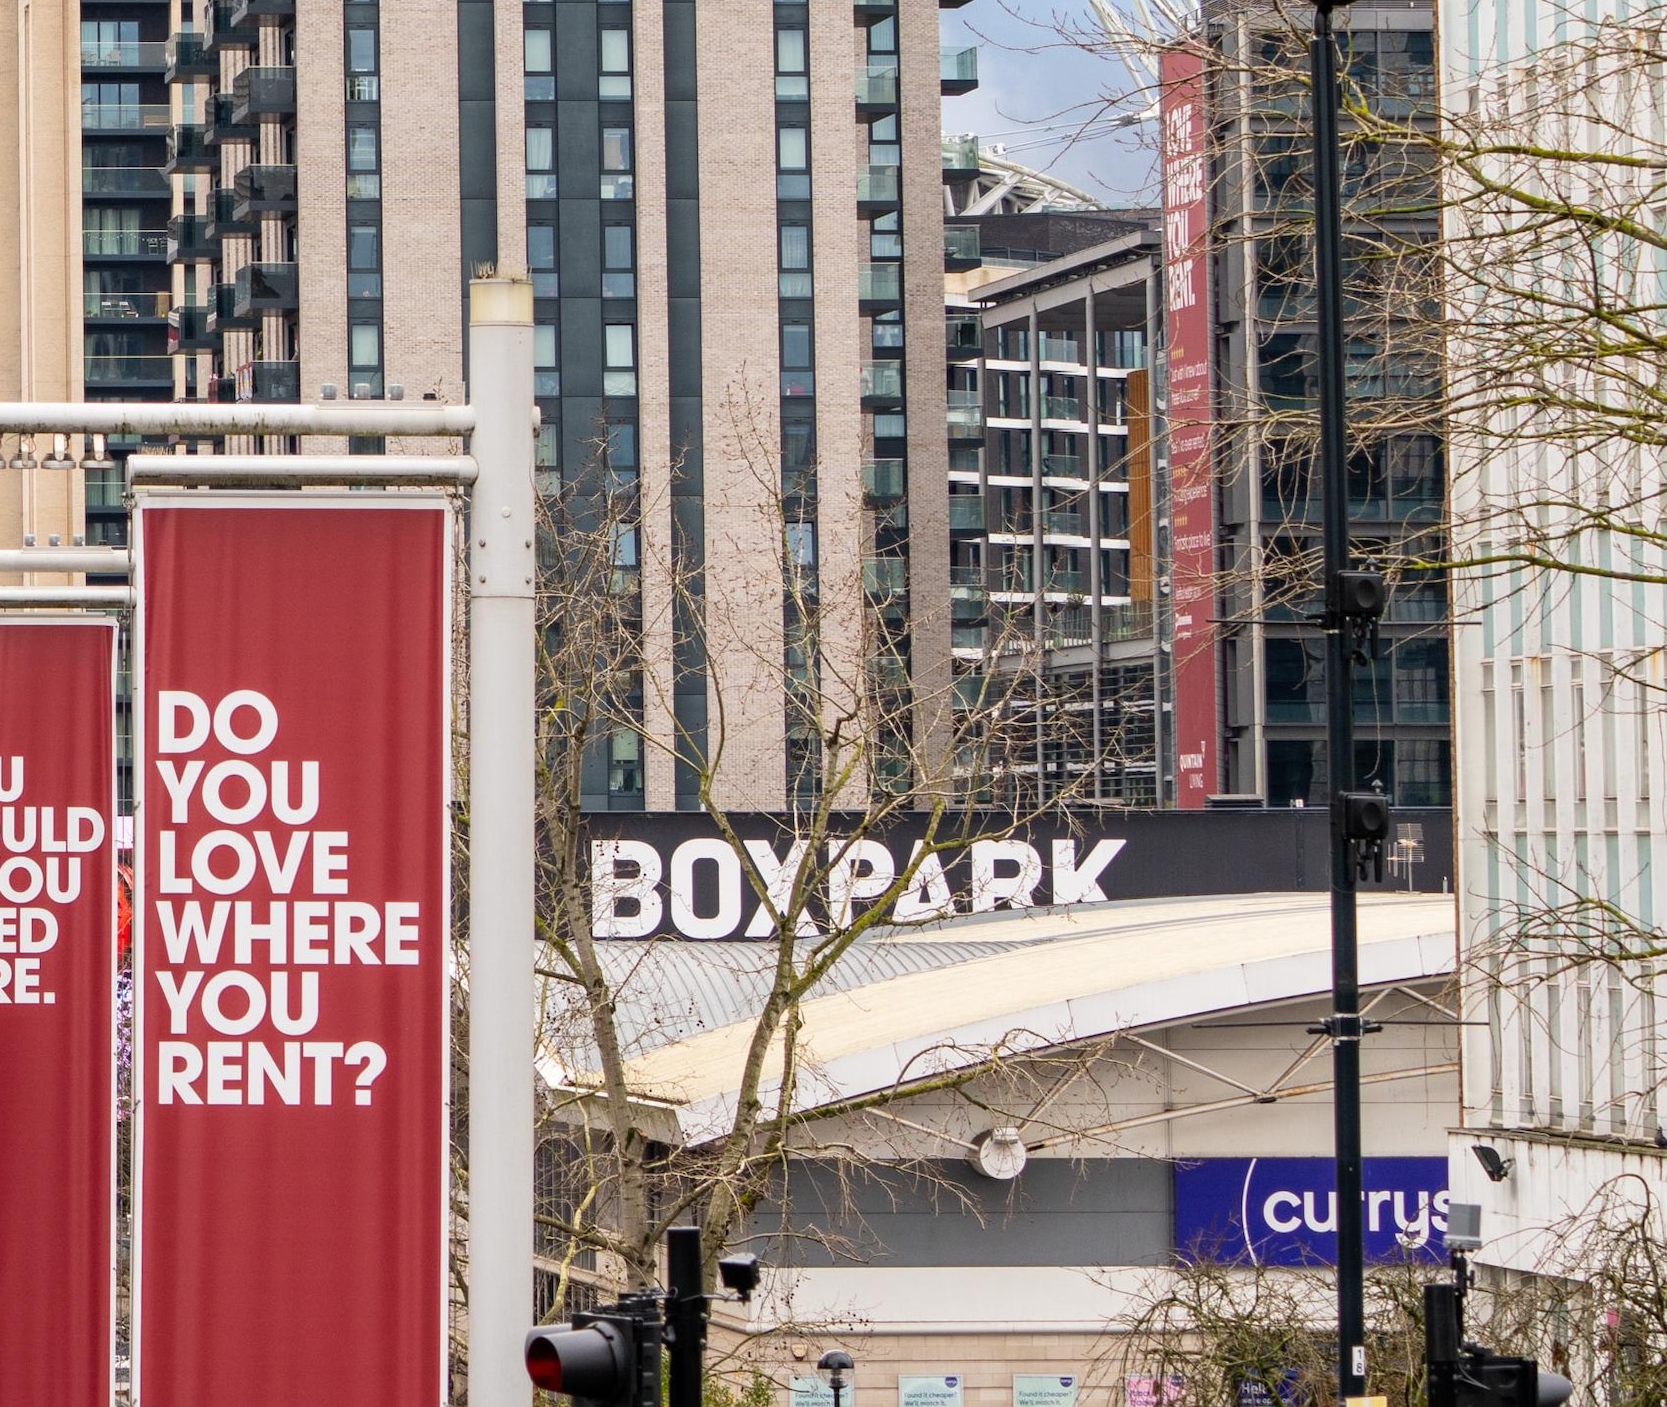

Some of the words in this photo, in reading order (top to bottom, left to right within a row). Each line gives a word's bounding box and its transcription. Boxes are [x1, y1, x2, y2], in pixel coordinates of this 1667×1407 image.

[1166, 103, 1192, 159] LOVE
[1166, 153, 1203, 208] WHERE
[1167, 208, 1189, 260] YOU
[159, 690, 278, 754] DO
[156, 760, 319, 824] YOU
[160, 830, 348, 894] LOVE
[592, 838, 1128, 939] BOXPARK
[156, 901, 419, 964] WHERE
[156, 970, 318, 1035] YOU
[159, 1041, 386, 1105] RENT?
